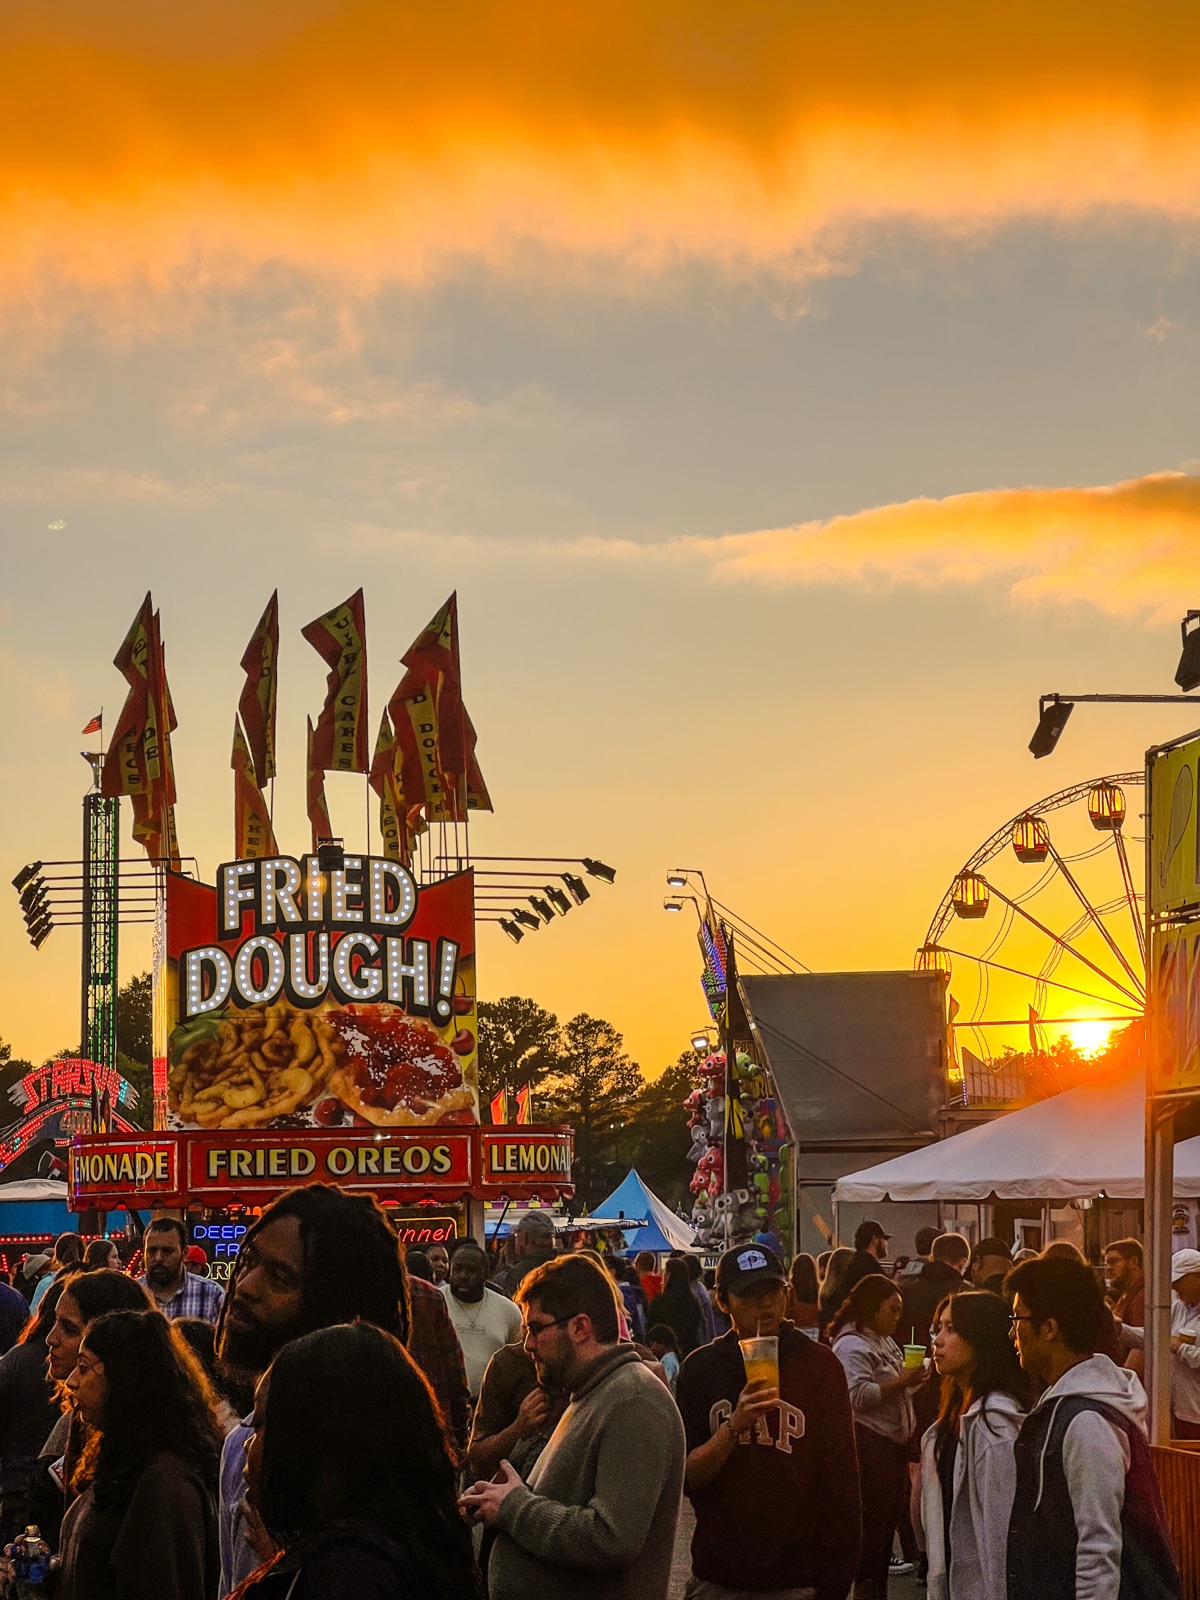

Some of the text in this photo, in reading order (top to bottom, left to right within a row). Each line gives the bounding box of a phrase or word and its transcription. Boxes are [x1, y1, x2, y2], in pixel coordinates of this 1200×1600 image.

[223, 857, 417, 932] FRIED
[185, 932, 458, 1017] DOUGH!
[74, 1151, 169, 1184] EMONADE
[207, 1145, 452, 1179] FRIED OREOS
[193, 1225, 247, 1239] DEEP
[214, 1243, 241, 1258] FR
